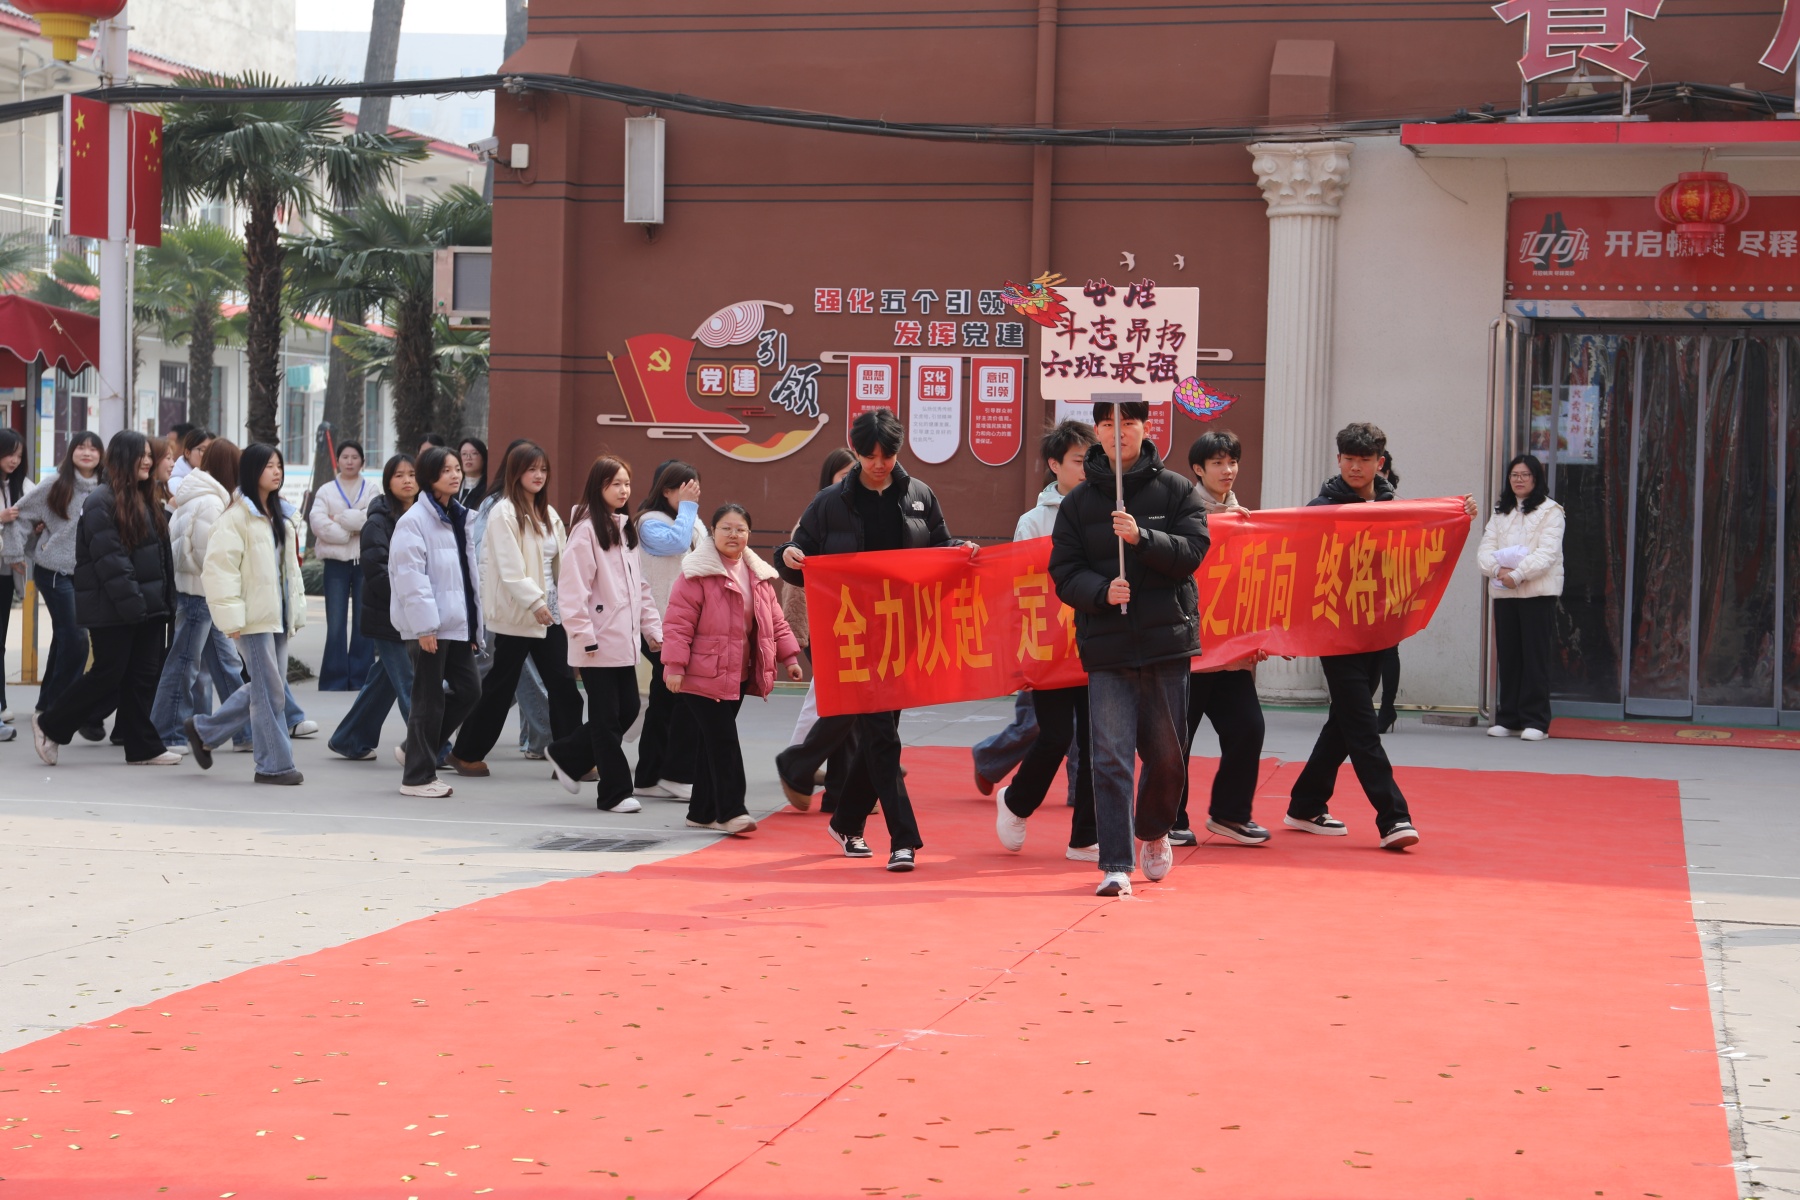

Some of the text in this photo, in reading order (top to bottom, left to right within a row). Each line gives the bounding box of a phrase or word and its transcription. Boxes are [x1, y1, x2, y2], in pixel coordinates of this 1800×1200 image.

[1519, 227, 1590, 265] 可口可乐
[1604, 230, 1798, 258] 开启畅 尽释
[815, 288, 1006, 315] 强化五个引领
[893, 321, 1024, 348] 发挥党建
[1055, 310, 1187, 354] 斗志昂扬
[700, 367, 756, 393] 党建
[756, 329, 821, 417] 引领
[862, 369, 885, 382] 思想
[923, 370, 947, 383] 文化
[986, 372, 1009, 384] 意识
[1040, 350, 1181, 385] 六班最强
[862, 384, 885, 396] 引领
[923, 385, 947, 397] 引领
[986, 386, 1009, 398] 引领
[1195, 538, 1298, 638] 之所向
[833, 573, 994, 684] 全力以赴
